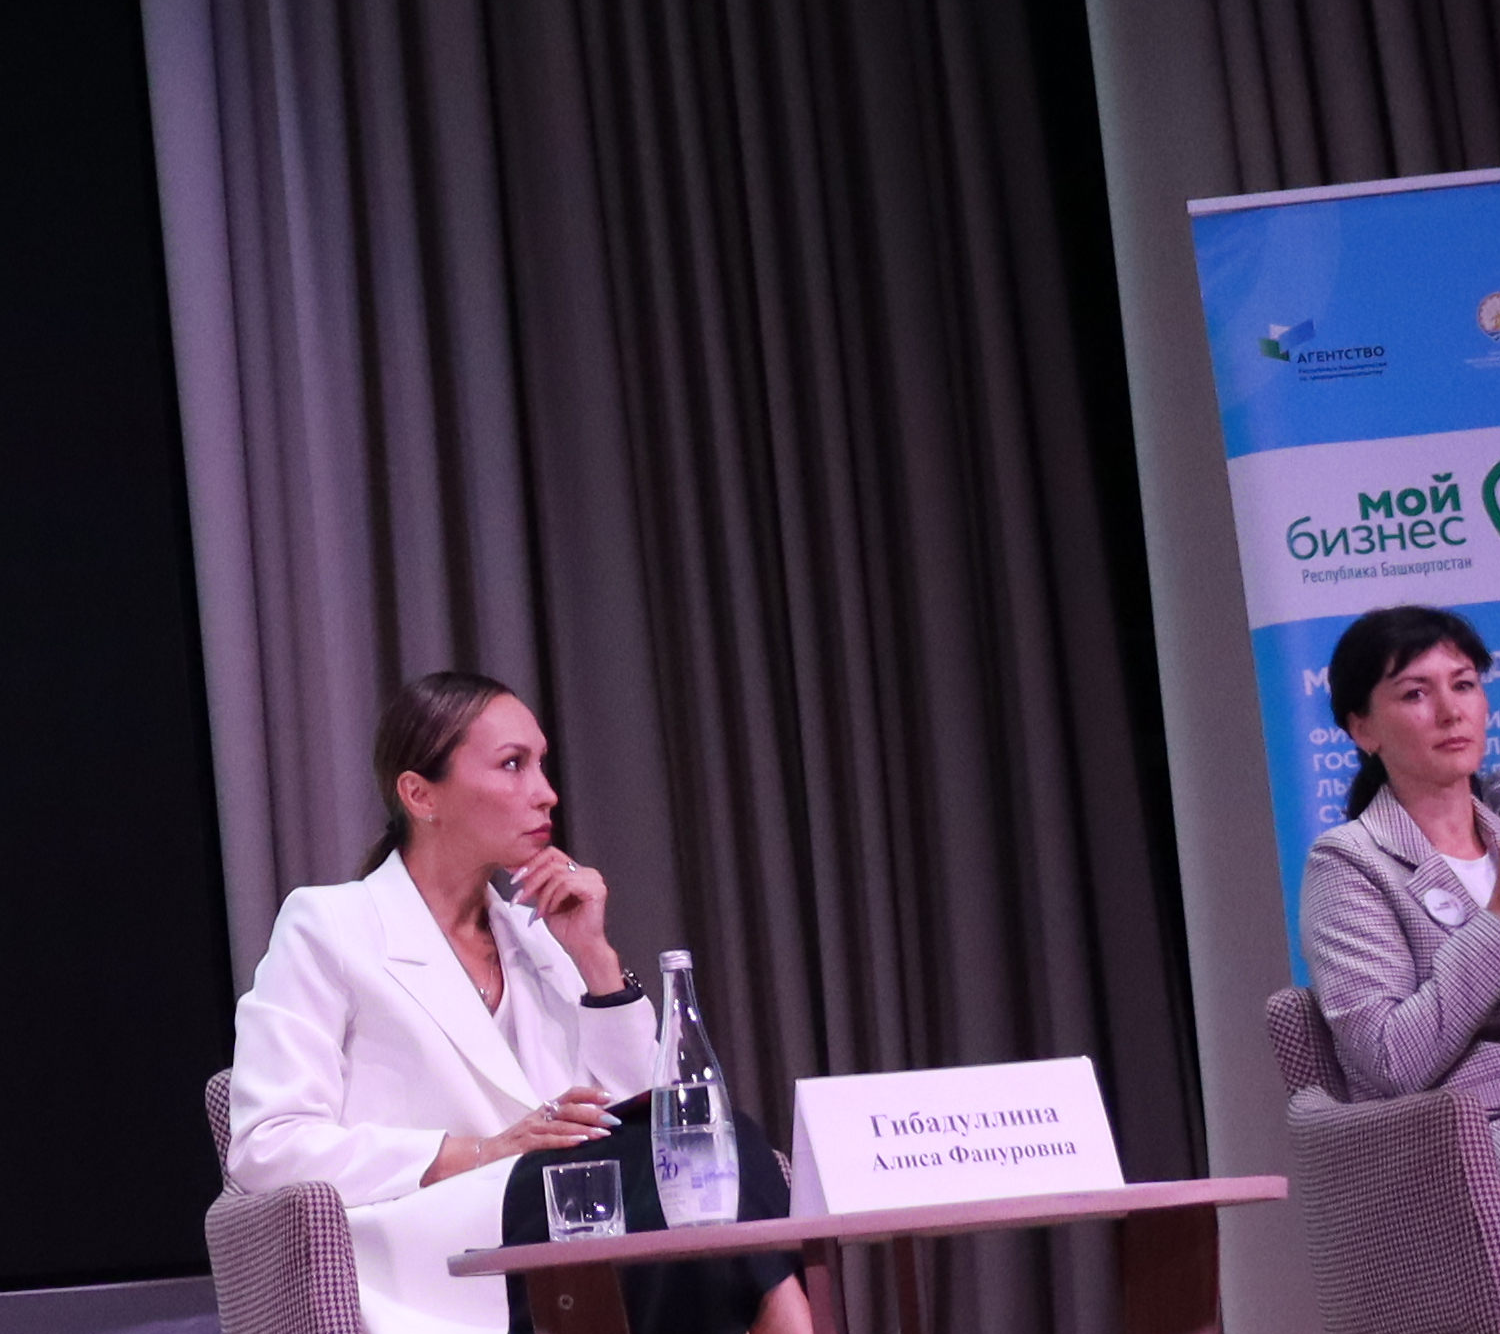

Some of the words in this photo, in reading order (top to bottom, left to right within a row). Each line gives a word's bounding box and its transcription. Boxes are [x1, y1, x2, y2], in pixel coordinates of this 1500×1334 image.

[1297, 345, 1385, 364] АГЕНТСТВО
[1357, 472, 1461, 521] мой
[1287, 516, 1467, 560] бизнес
[1302, 563, 1378, 585] Республика
[1381, 557, 1472, 577] Башкортостан
[869, 1107, 1060, 1138] Гибадуллина
[872, 1151, 943, 1171] Алиса
[949, 1140, 1078, 1166] Фануровна
